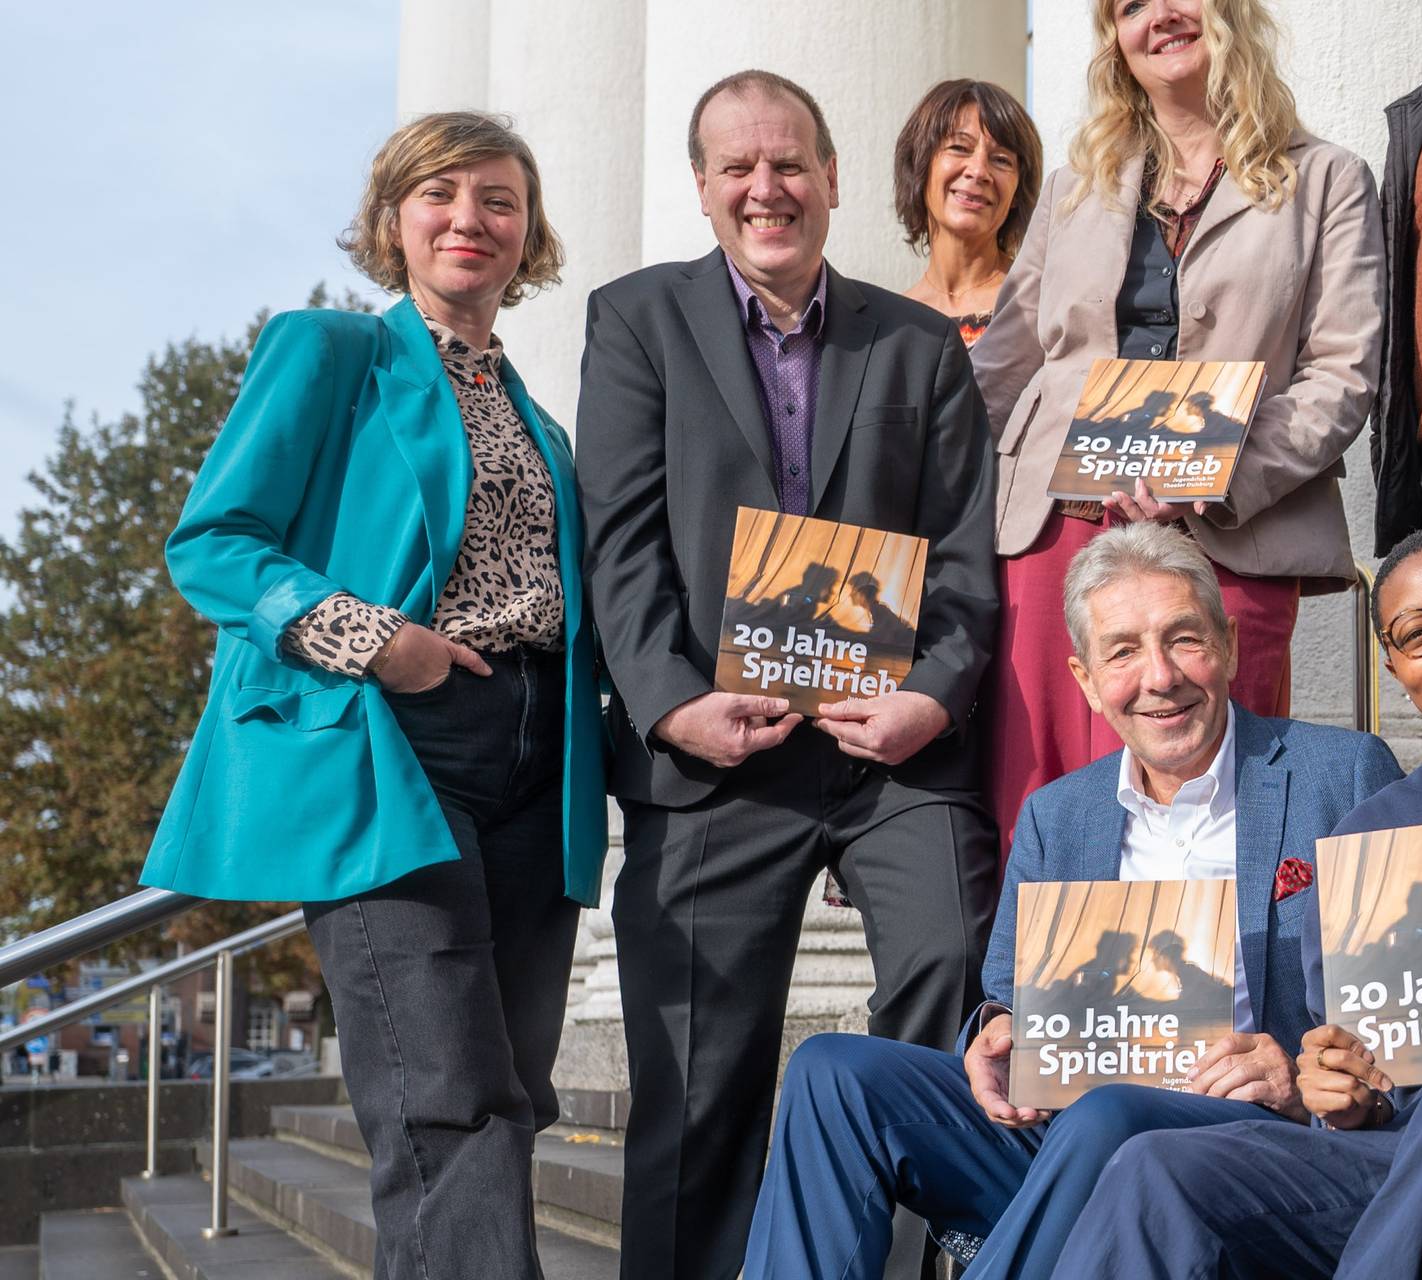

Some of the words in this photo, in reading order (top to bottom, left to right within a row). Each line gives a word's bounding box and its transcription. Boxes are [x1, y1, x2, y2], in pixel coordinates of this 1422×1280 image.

[1073, 435, 1111, 453] 20
[1116, 434, 1197, 456] Jahre
[1077, 454, 1222, 481] Spieltrieb
[733, 624, 774, 650] 20
[780, 626, 867, 664] Jahre
[742, 652, 897, 697] Spieltrieb
[1340, 981, 1388, 1013] 20
[1025, 1013, 1071, 1039] 20
[1079, 1005, 1179, 1039] Jahre
